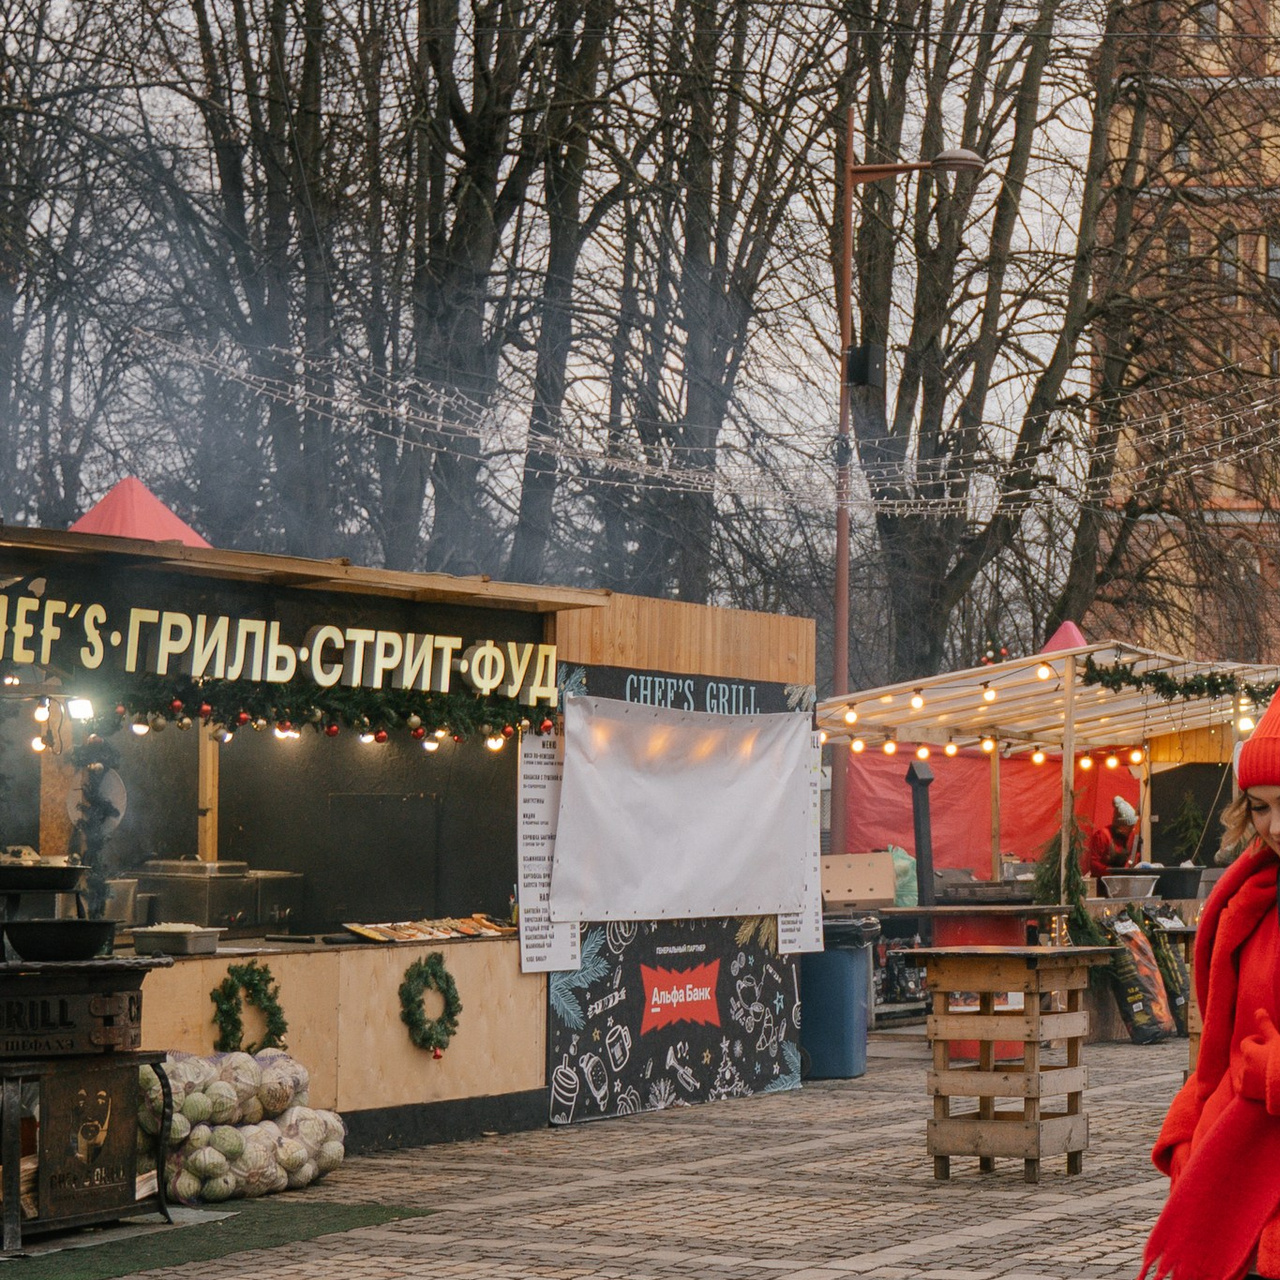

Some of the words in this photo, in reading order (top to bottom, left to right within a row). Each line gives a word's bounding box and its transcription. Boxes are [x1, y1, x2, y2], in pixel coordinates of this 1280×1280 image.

[125, 608, 297, 683] ГРИЛЬ
[311, 625, 463, 694] СТРИТ
[471, 640, 559, 708] ФУД
[625, 674, 694, 712] CHEF'S
[706, 681, 760, 716] GRILL
[656, 944, 686, 954] ГЕНЕРАЛЬНЫЙ
[686, 944, 706, 952] ПАРТНЕР
[651, 985, 685, 1008] Альфа
[686, 984, 711, 1002] Банк
